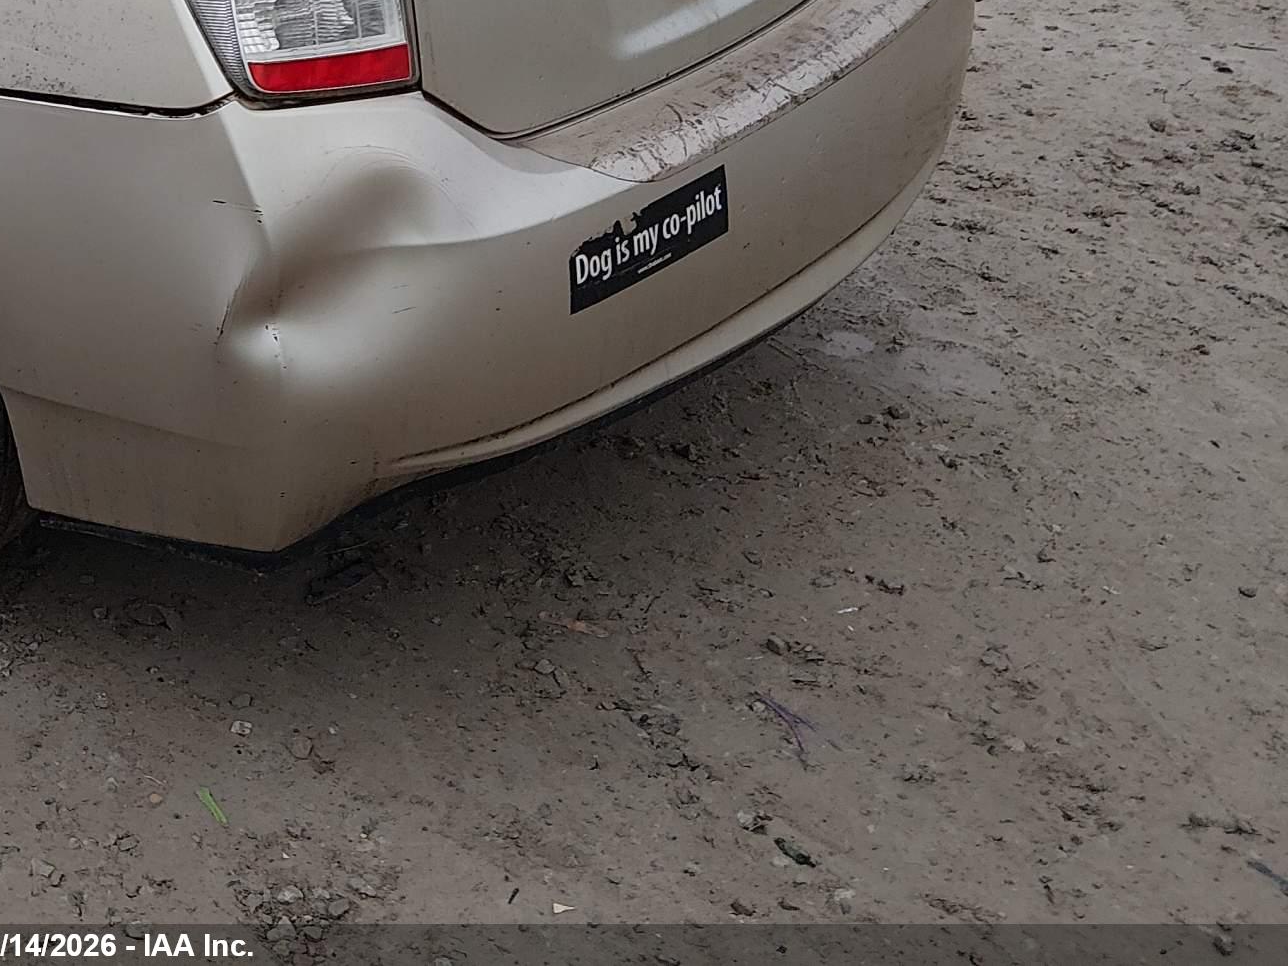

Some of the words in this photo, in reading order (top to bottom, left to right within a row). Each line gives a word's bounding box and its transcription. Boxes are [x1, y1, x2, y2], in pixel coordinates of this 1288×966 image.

[575, 247, 612, 285] Dog
[615, 236, 630, 266] is
[632, 223, 659, 256] my
[662, 184, 723, 240] co-pilot
